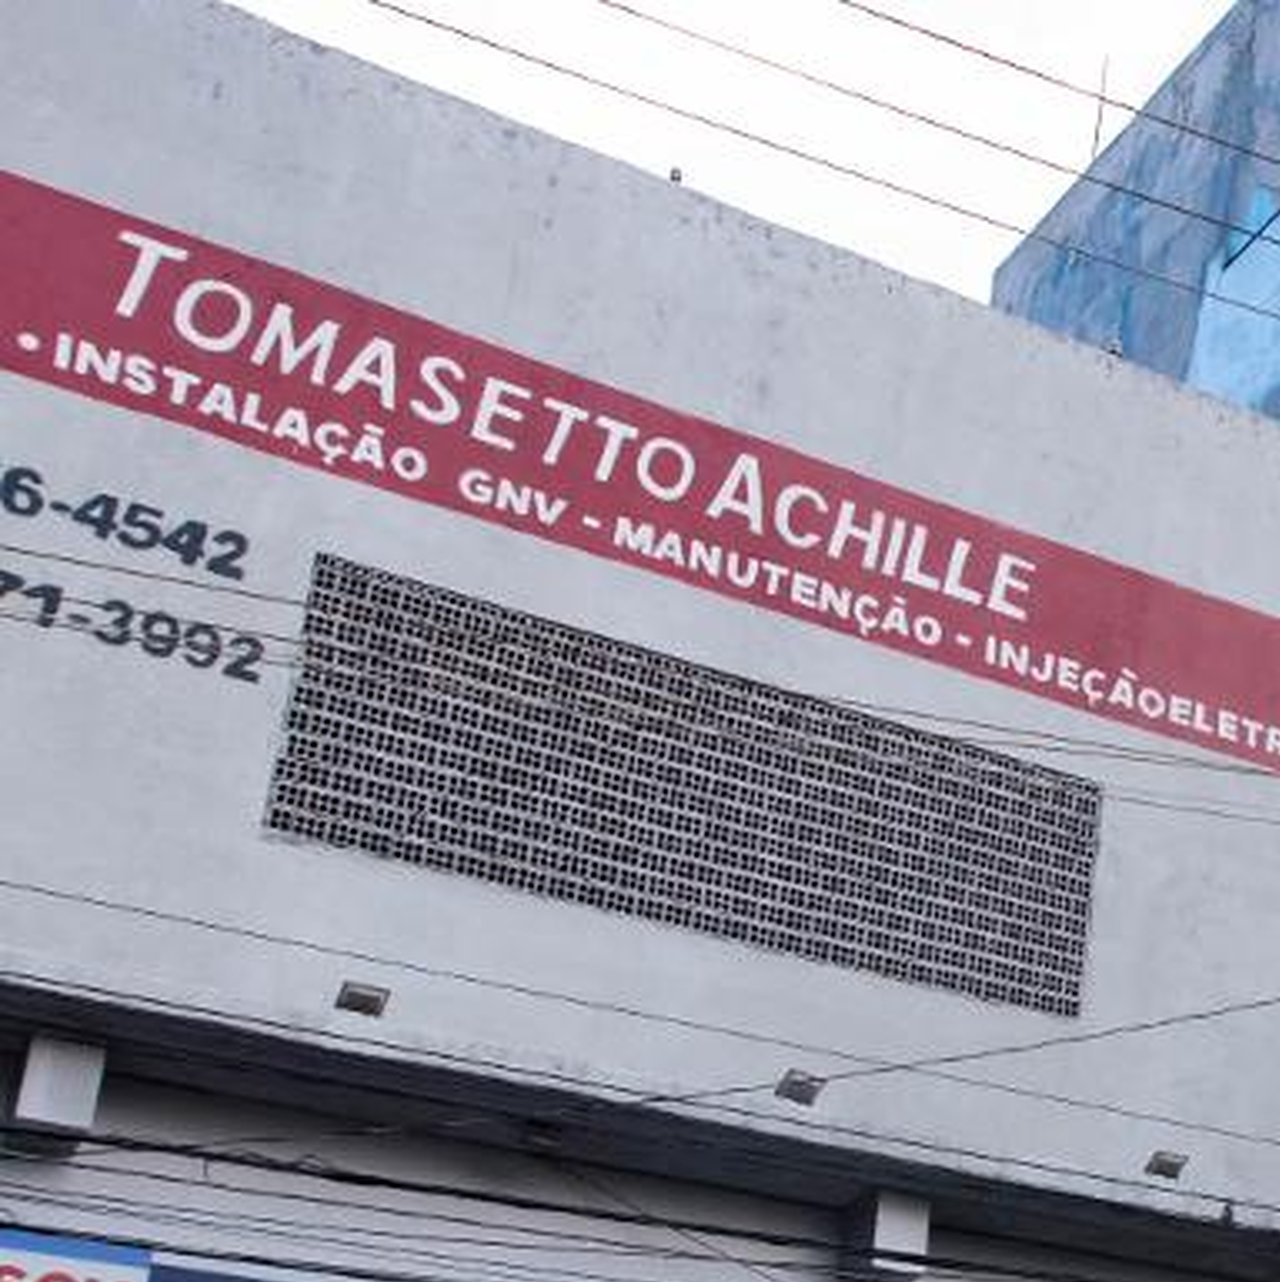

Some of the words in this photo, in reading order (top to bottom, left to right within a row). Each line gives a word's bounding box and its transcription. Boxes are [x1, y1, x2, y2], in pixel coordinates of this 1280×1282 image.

[0, 466, 249, 581] 6-4542
[52, 333, 429, 481] INSTALAÇÃO
[457, 467, 569, 526] GNV
[613, 516, 943, 647] MANUTENÇÃO
[114, 230, 697, 502] TOMASETTO
[705, 453, 1038, 620] ACHILLE
